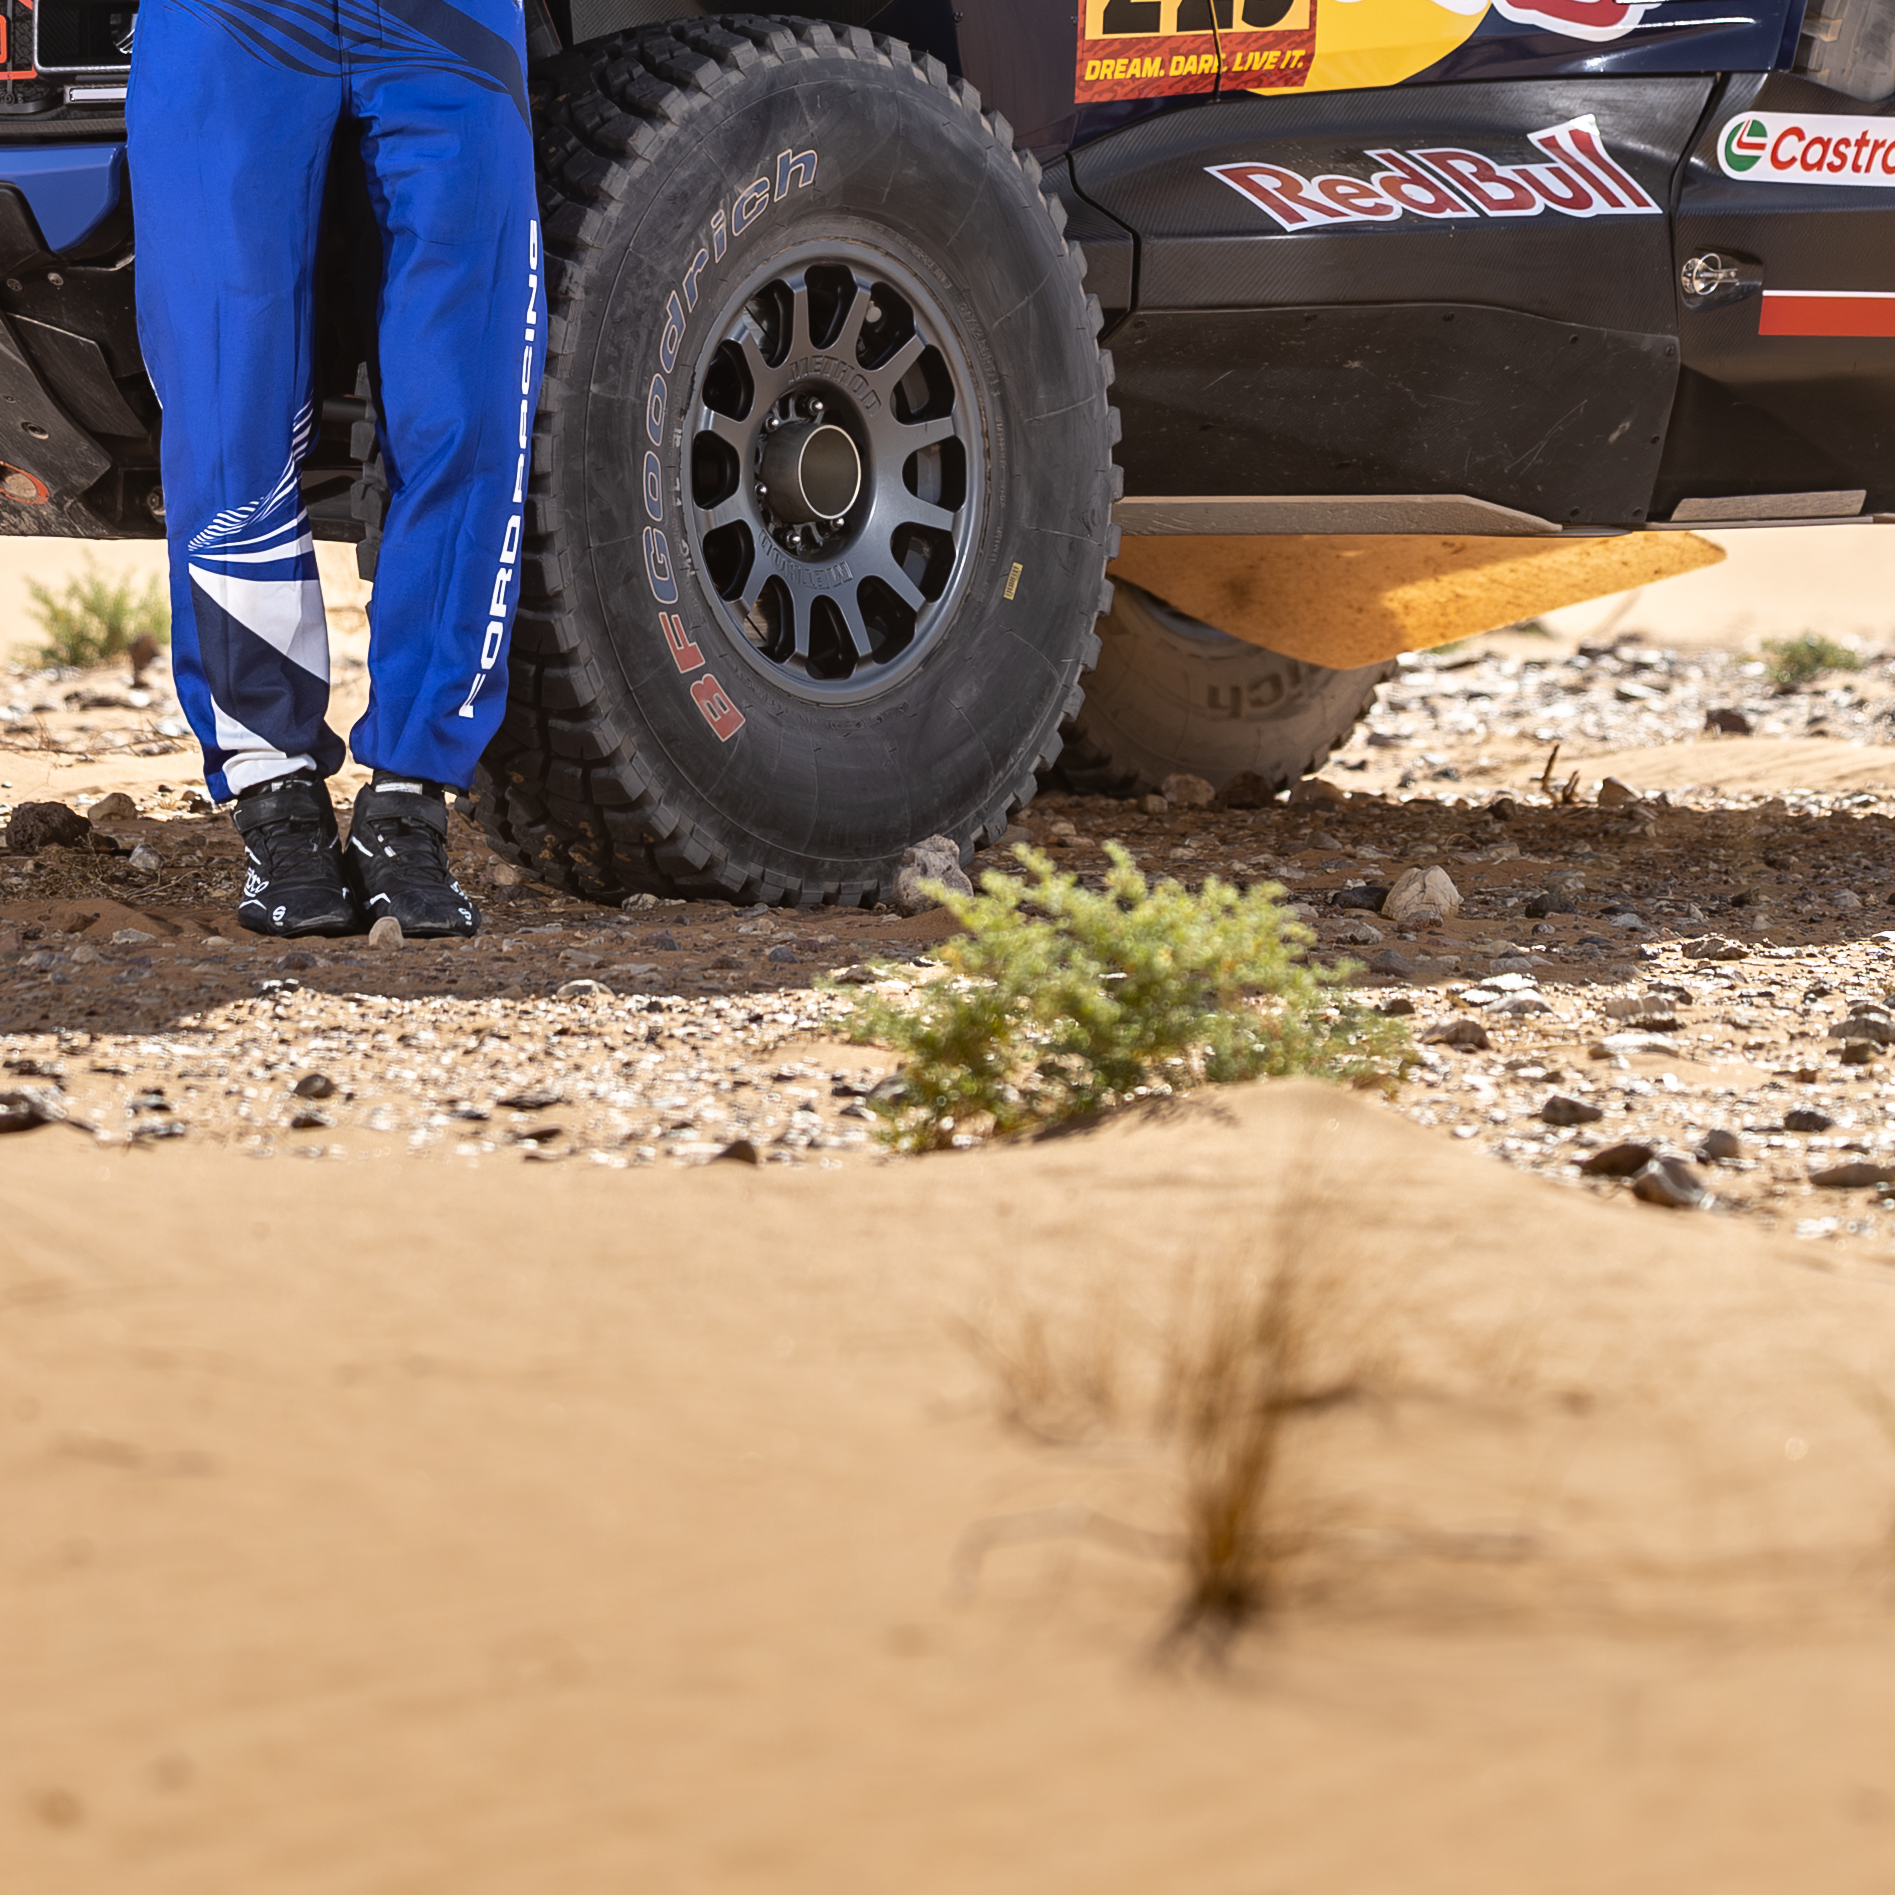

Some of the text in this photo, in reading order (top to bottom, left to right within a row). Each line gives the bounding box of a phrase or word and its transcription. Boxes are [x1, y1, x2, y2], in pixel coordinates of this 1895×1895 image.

[1085, 56, 1165, 81] DREAM.
[1231, 50, 1281, 72] LIVE
[1280, 49, 1306, 70] IT.
[1203, 113, 1663, 232] Red Bull
[788, 354, 882, 418] METHOD
[457, 217, 541, 720] FORD RACING
